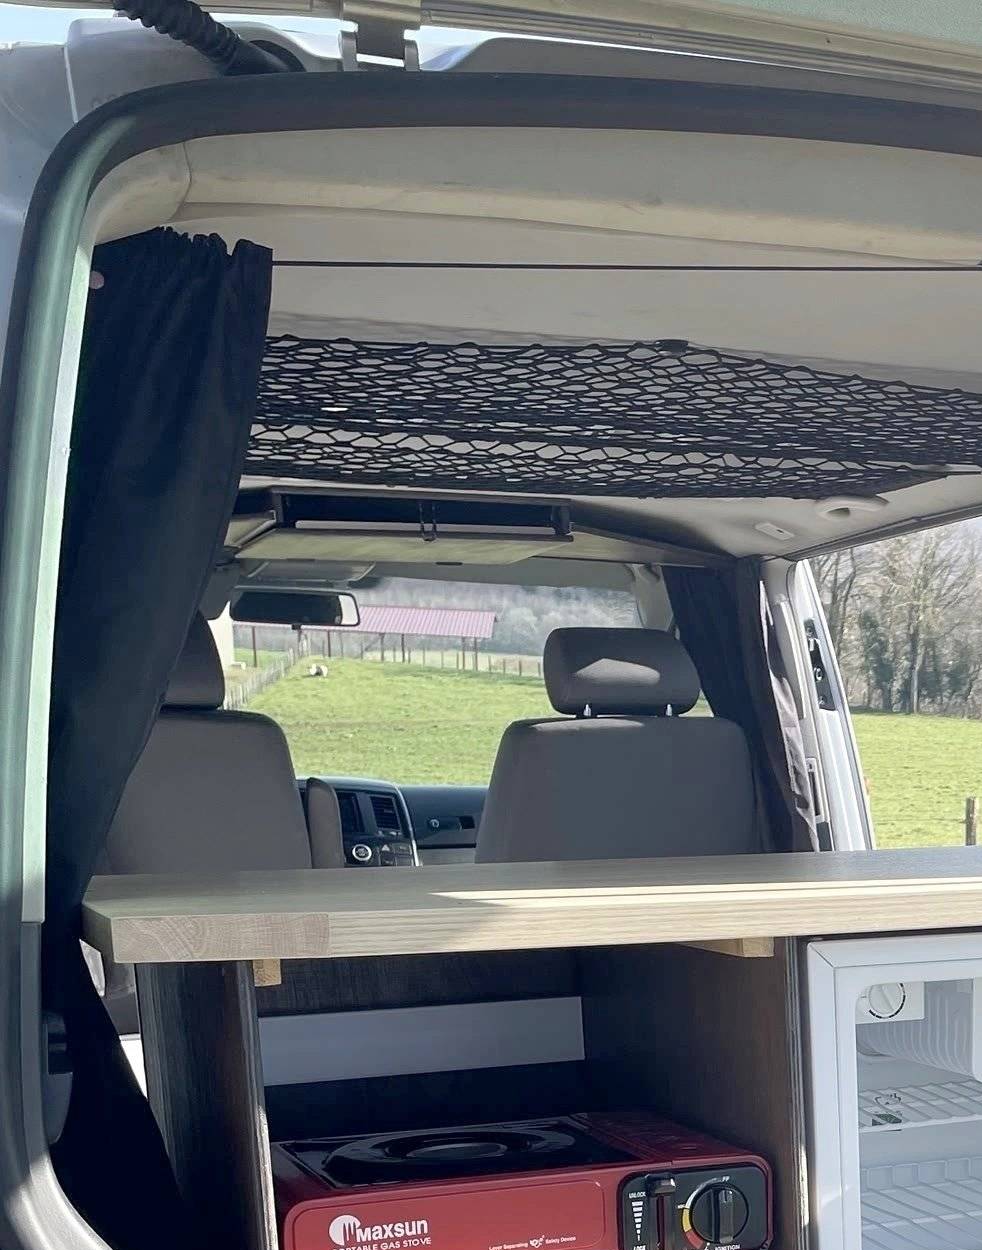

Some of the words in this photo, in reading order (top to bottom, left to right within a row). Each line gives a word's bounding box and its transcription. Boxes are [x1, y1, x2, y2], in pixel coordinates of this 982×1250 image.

[356, 1219, 429, 1242] Maxsun
[380, 1240, 401, 1250] GAS
[403, 1236, 432, 1248] STOVE
